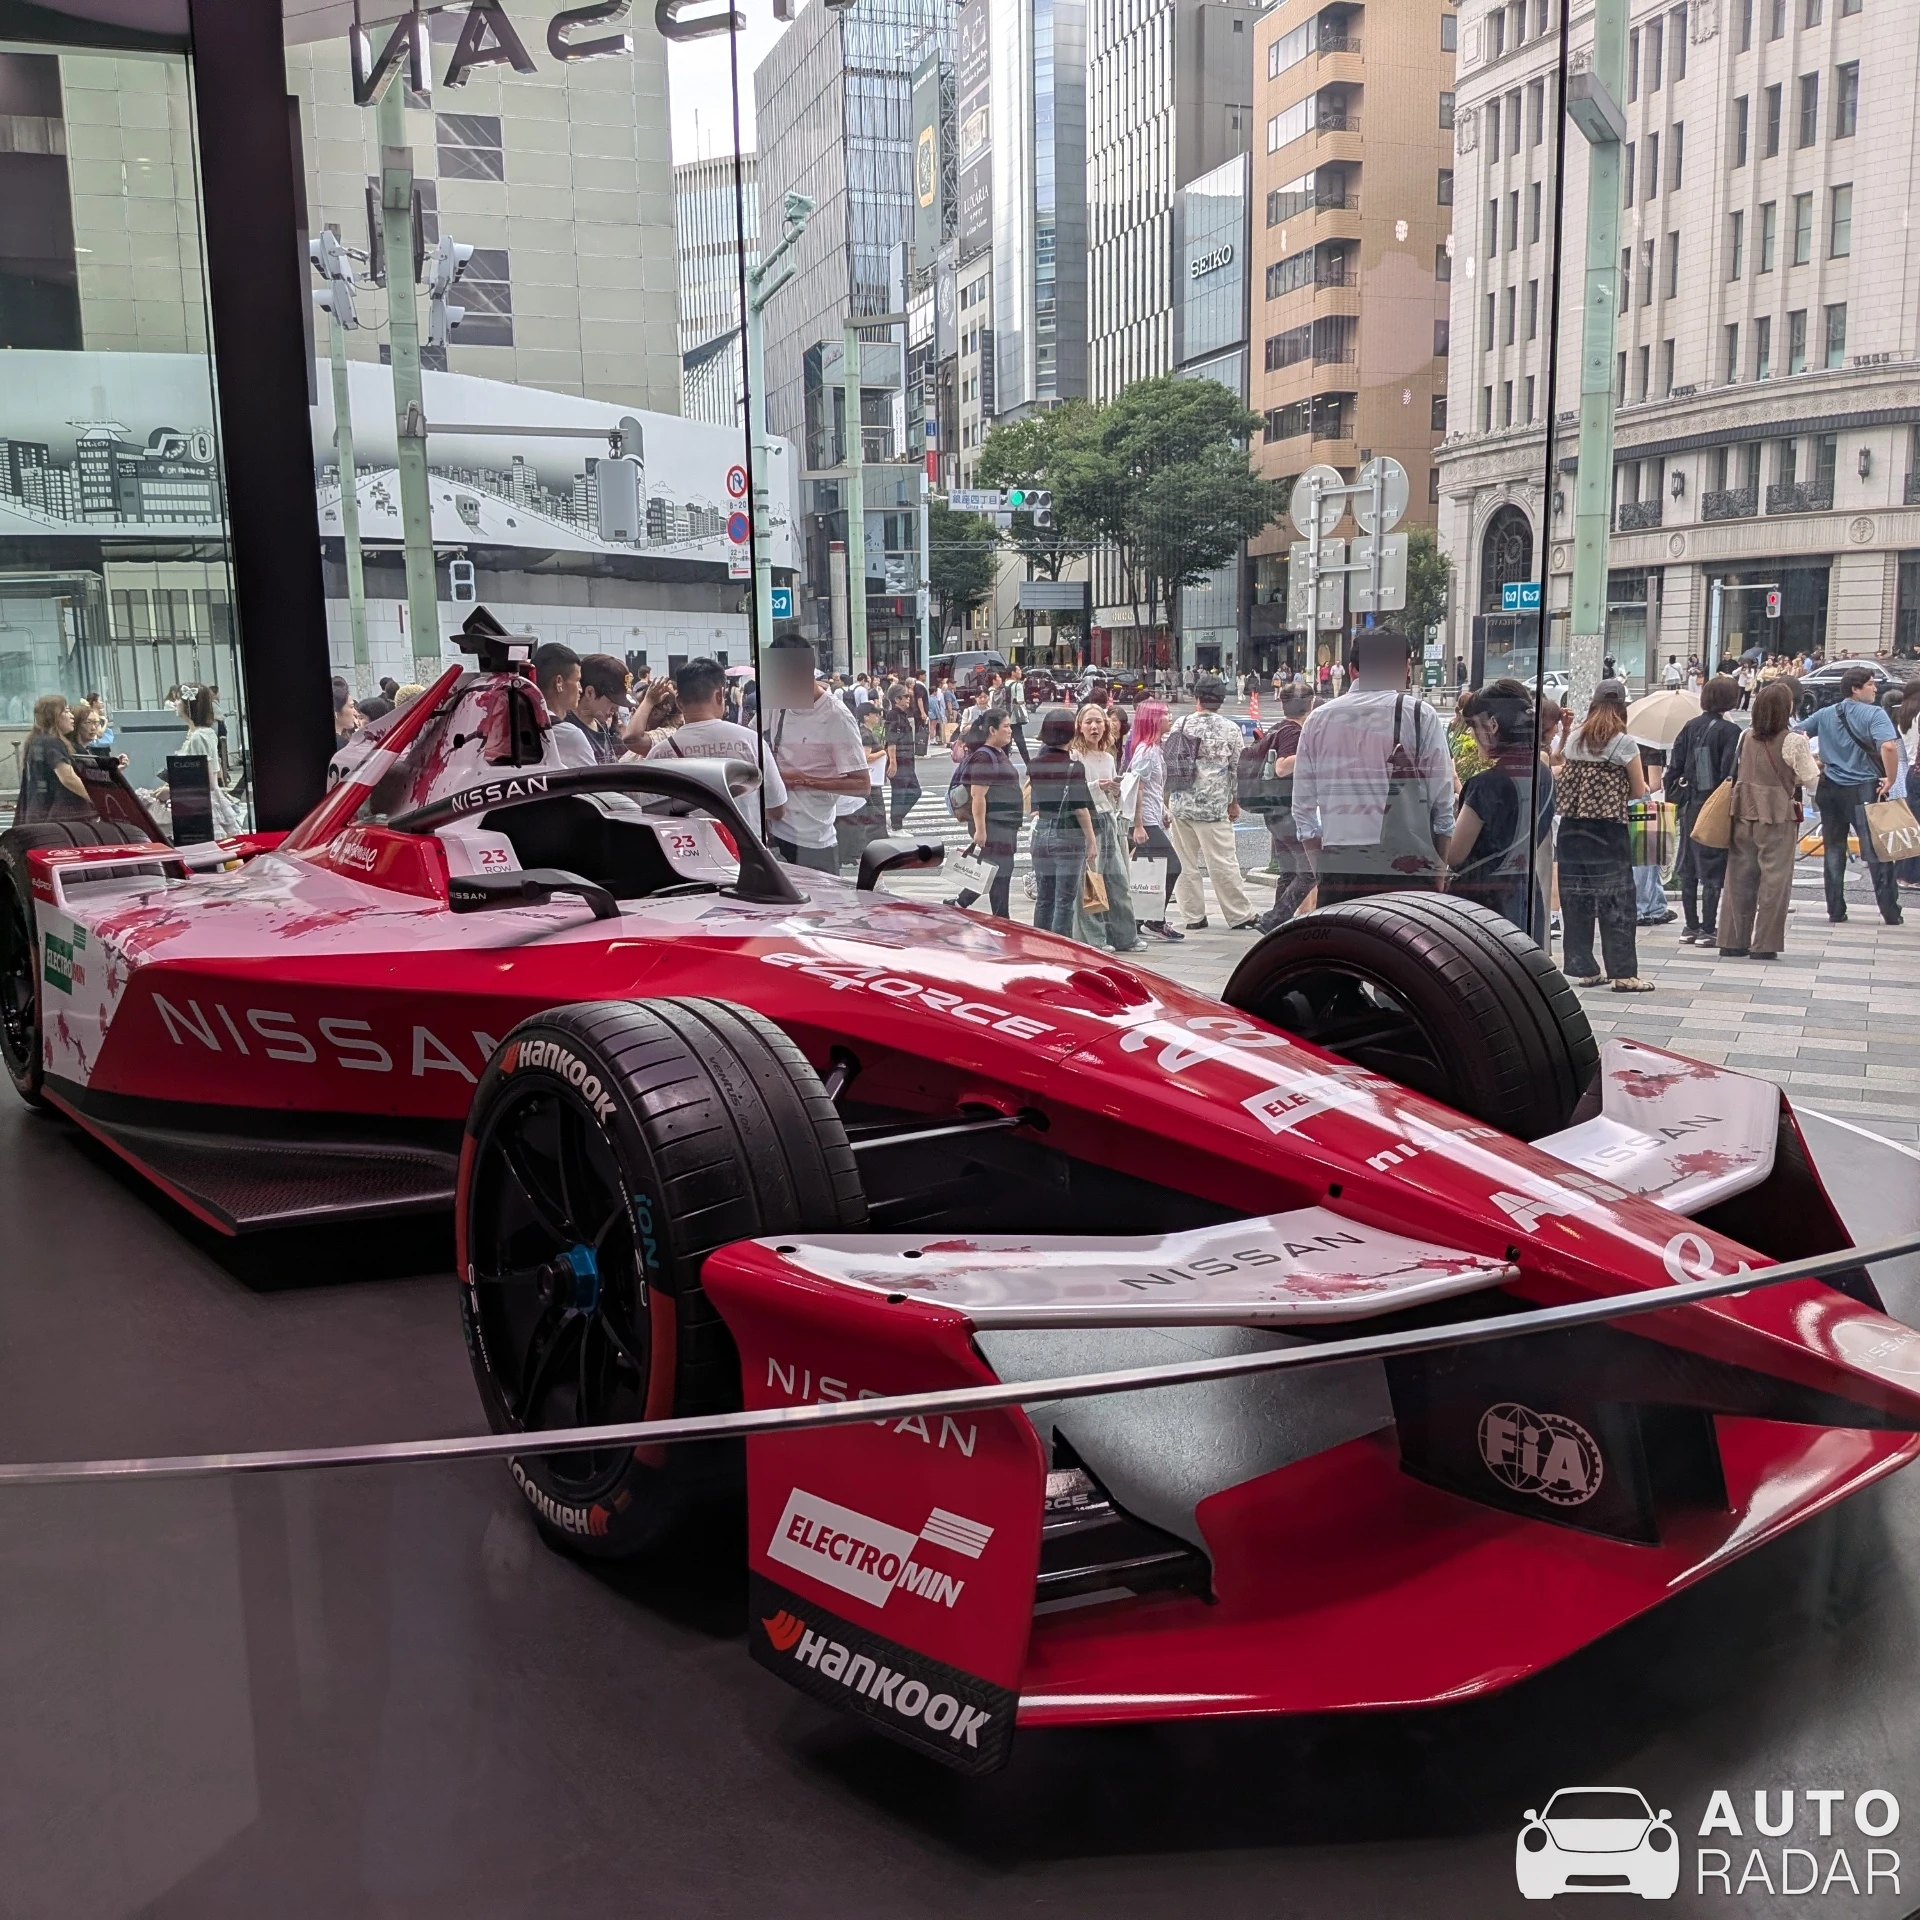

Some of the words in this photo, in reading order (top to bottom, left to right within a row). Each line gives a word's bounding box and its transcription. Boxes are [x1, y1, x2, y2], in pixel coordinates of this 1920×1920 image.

[1191, 244, 1234, 279] SEIKO
[729, 501, 747, 510] 8-20
[952, 495, 997, 505] 銀座四丁目
[451, 776, 548, 814] NISSAN
[478, 849, 508, 865] 23
[669, 835, 697, 849] 23
[484, 864, 513, 875] ROW
[1119, 1016, 1292, 1074] 23
[1365, 1126, 1503, 1173] nismo
[1488, 1171, 1629, 1234] ABB
[1118, 1231, 1367, 1291] NISSAN
[786, 1513, 965, 1609] ELECTROMIN
